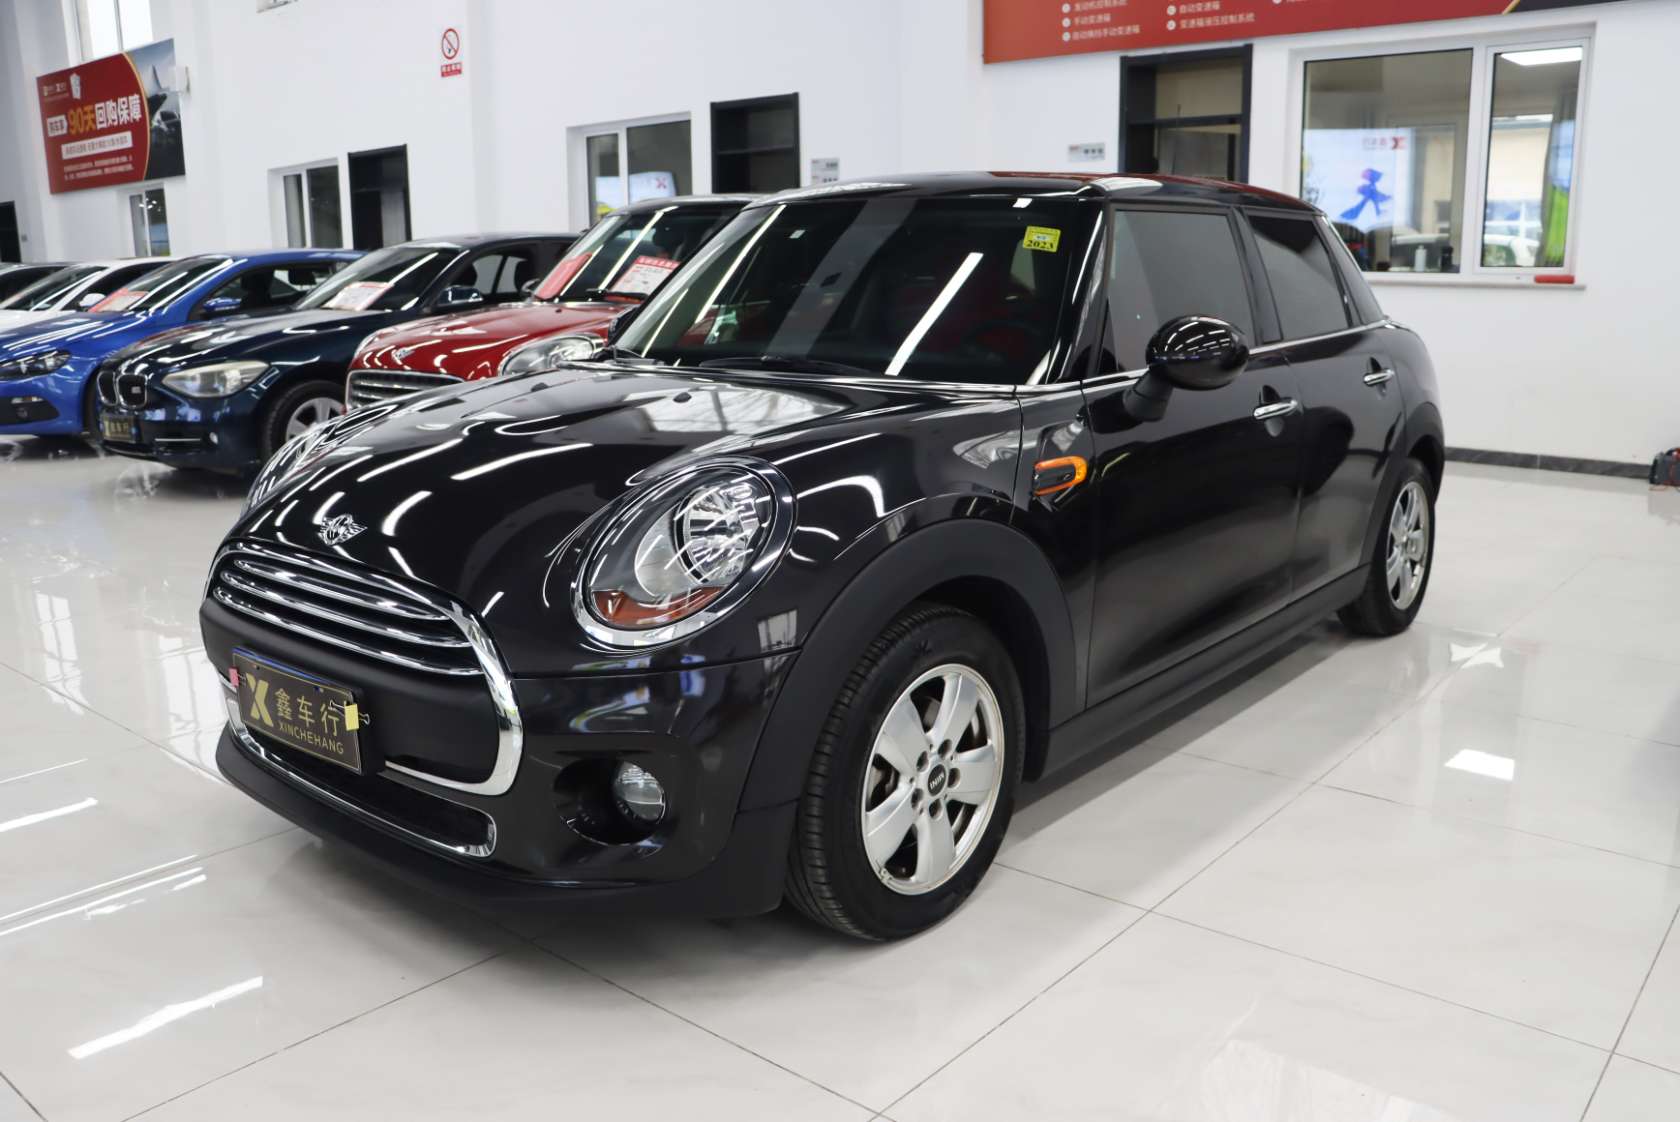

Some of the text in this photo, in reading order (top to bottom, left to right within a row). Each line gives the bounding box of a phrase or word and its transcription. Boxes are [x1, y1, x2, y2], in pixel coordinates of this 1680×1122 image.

[67, 93, 142, 135] 90天回购保障
[274, 687, 340, 737] 鑫车行
[278, 721, 345, 756] XINCHEHANG
[929, 771, 945, 790] MINI
